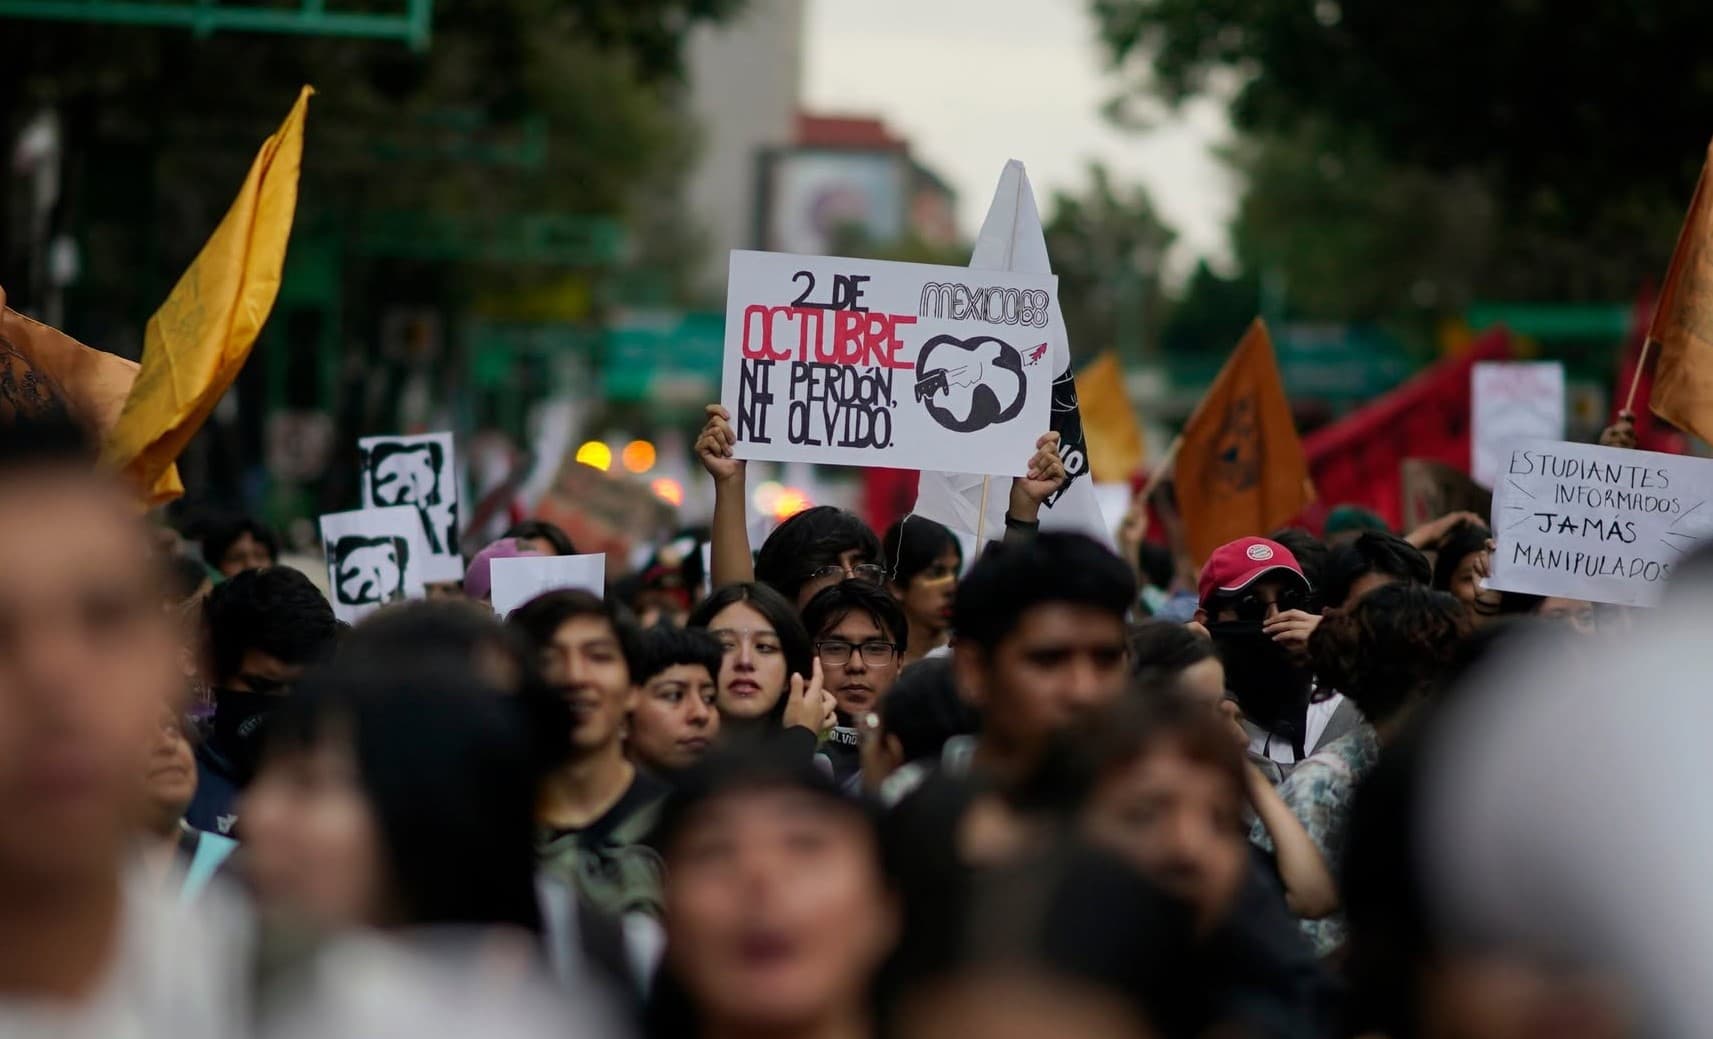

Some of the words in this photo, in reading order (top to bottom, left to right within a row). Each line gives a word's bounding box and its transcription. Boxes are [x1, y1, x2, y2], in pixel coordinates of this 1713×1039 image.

[791, 271, 834, 308] 2
[833, 275, 870, 312] DE
[742, 305, 917, 369] OCTUBRE
[740, 359, 776, 404] NI
[790, 361, 898, 408] PERDÓN,
[737, 401, 772, 443] NI
[788, 401, 895, 449] OLVIDO.
[1509, 450, 1669, 489] ESTUDIANTES
[1555, 484, 1681, 513] INFORMADOS
[1534, 513, 1637, 543] JAMÁS
